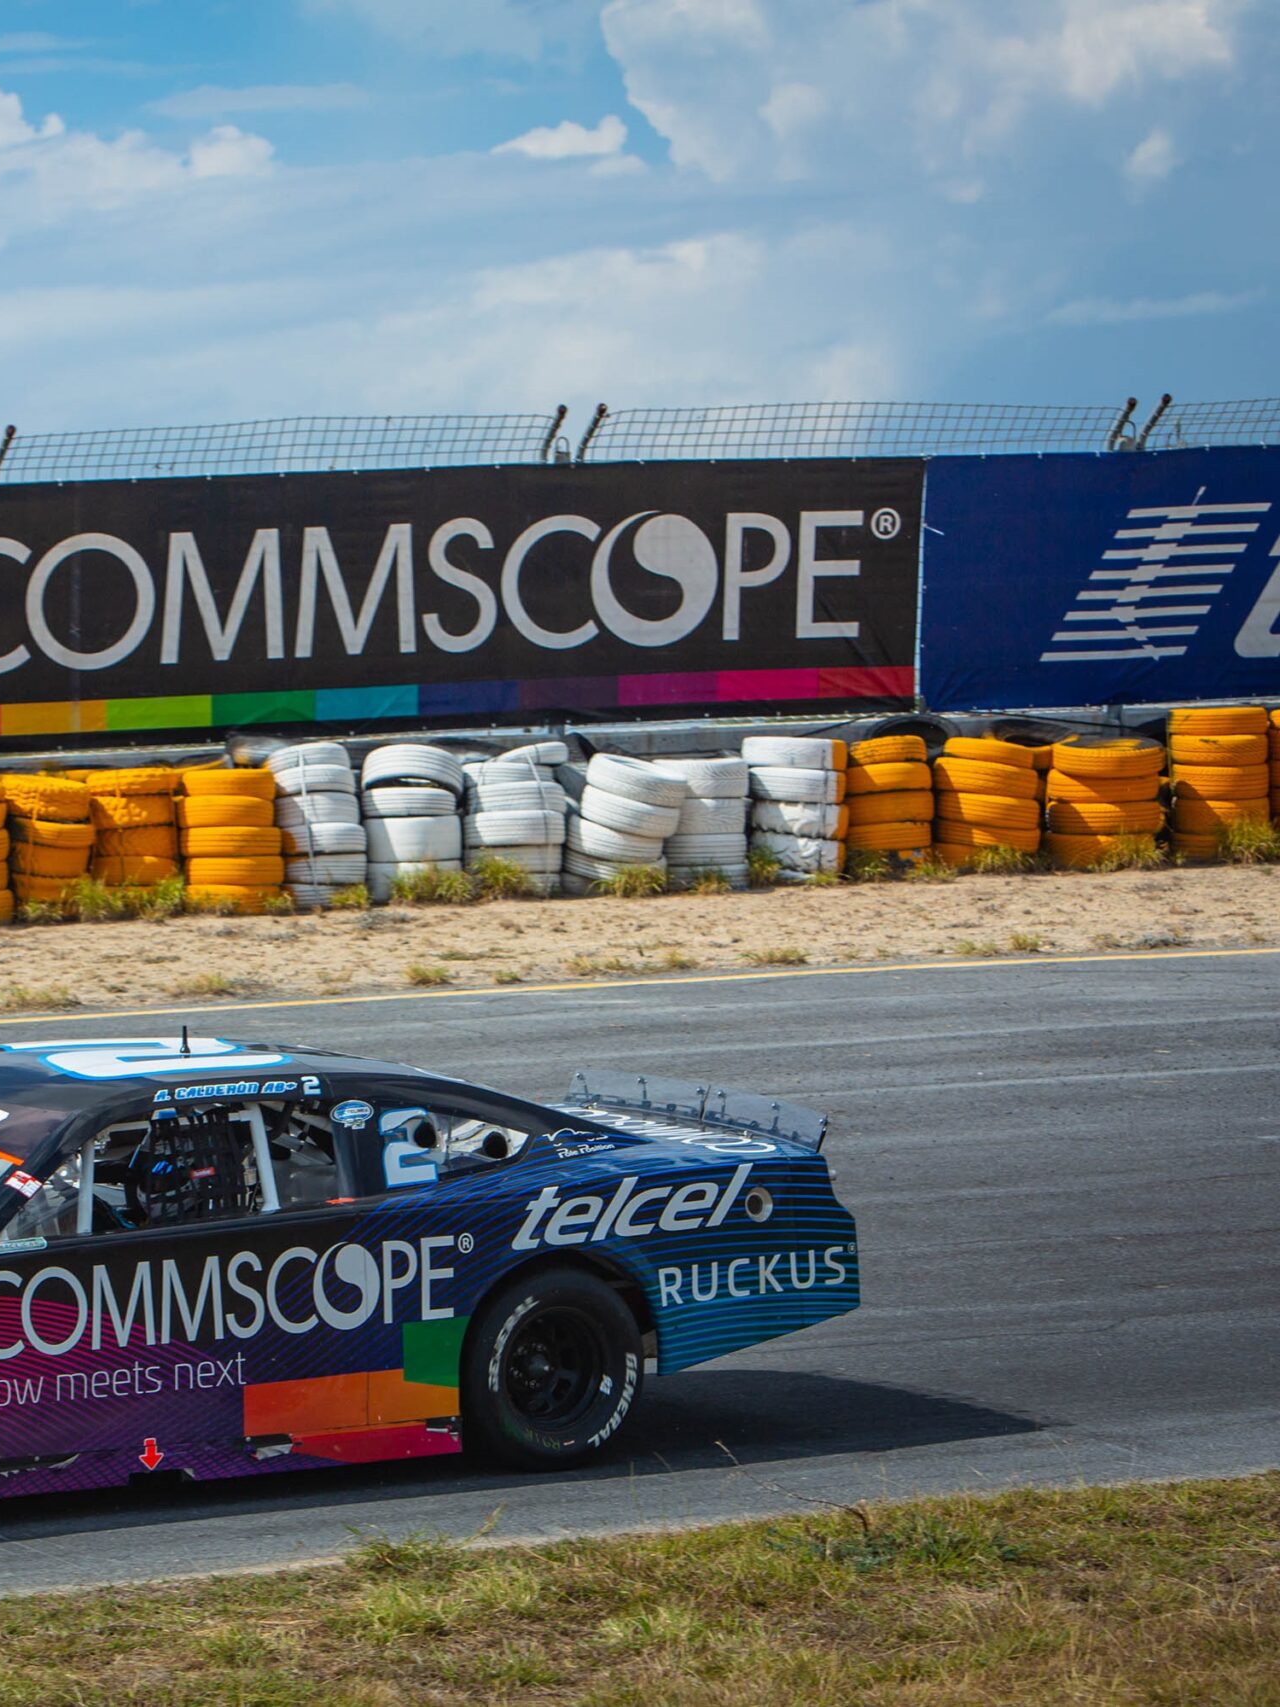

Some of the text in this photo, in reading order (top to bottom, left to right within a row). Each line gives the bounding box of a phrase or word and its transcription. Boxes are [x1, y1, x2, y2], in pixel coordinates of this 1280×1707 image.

[301, 1076, 321, 1095] 2
[379, 1107, 440, 1189] 2
[511, 1163, 754, 1250] telcel
[56, 1361, 164, 1400] meets
[173, 1352, 246, 1390] next
[587, 1352, 638, 1448] GENERAL
